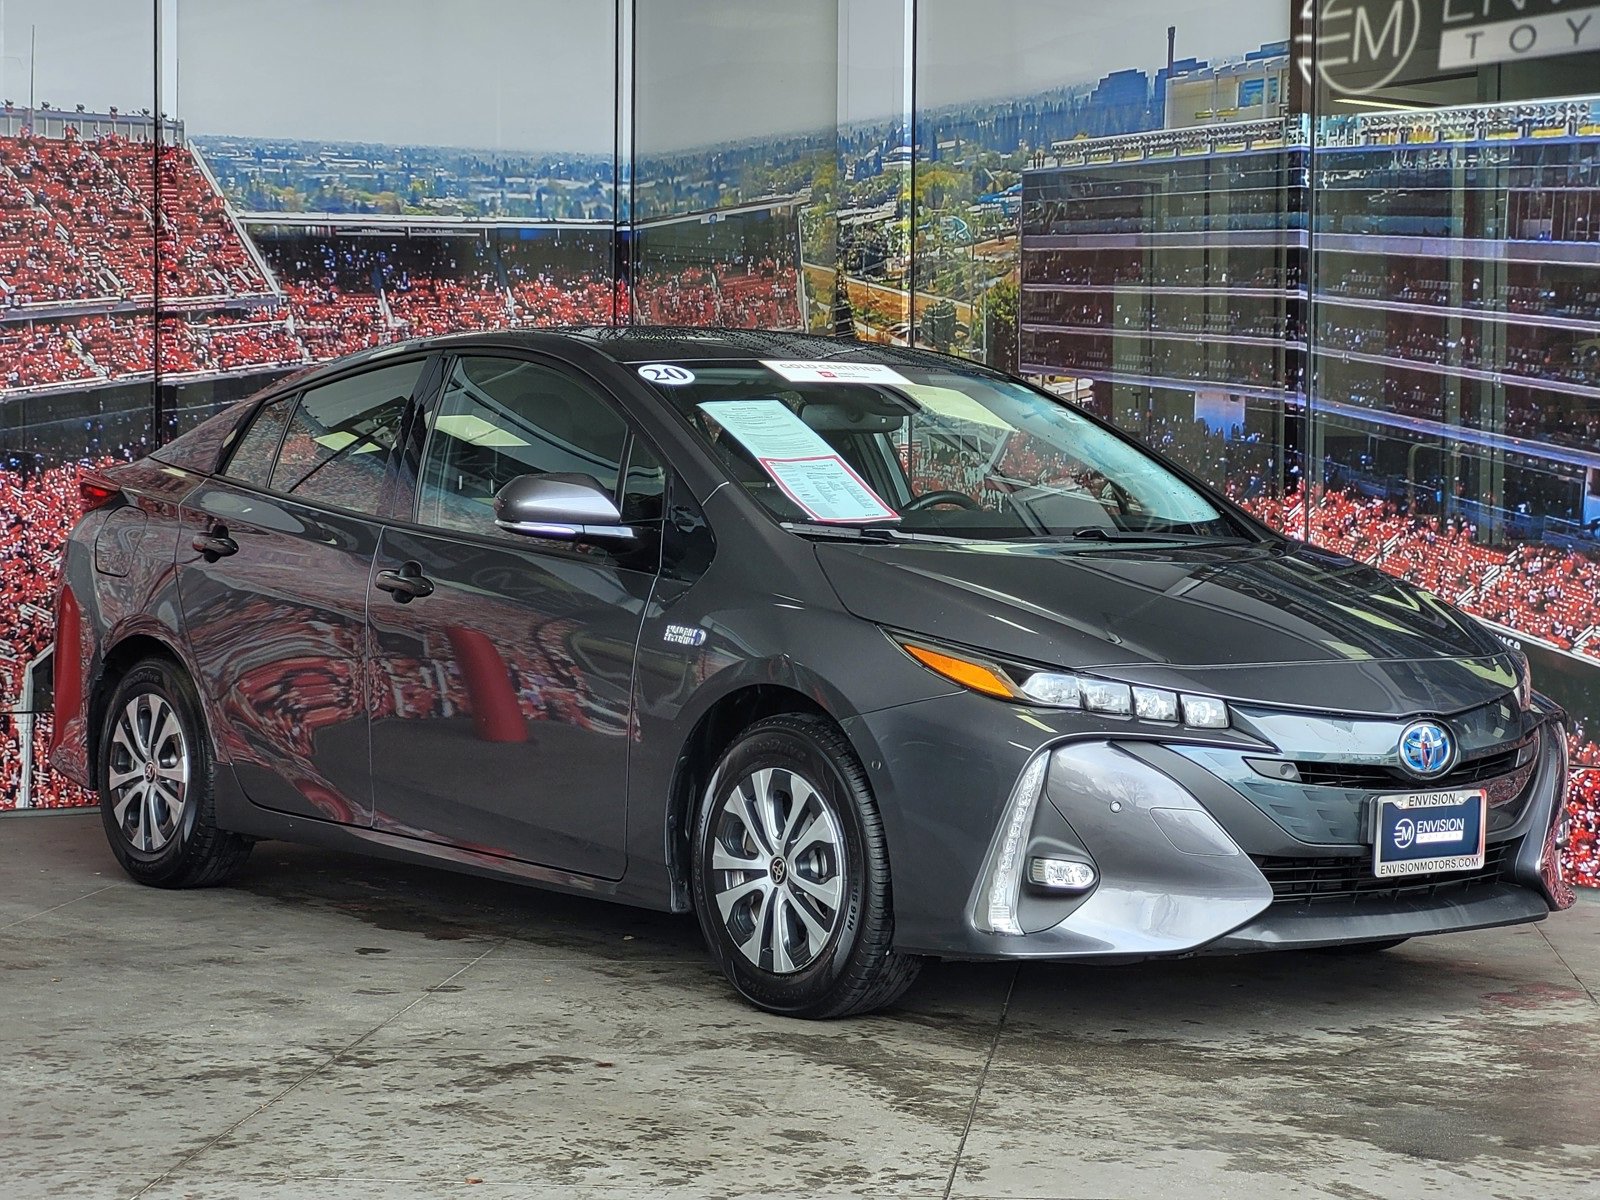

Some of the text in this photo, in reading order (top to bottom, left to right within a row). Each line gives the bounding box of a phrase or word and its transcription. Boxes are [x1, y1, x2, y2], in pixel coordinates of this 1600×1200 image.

[642, 368, 688, 381] 20
[818, 364, 883, 372] CERTIFIED
[1408, 793, 1456, 807] ENVISION
[1416, 818, 1465, 833] ENVISION
[1380, 857, 1479, 875] ENVISIONMOTORS.COM
